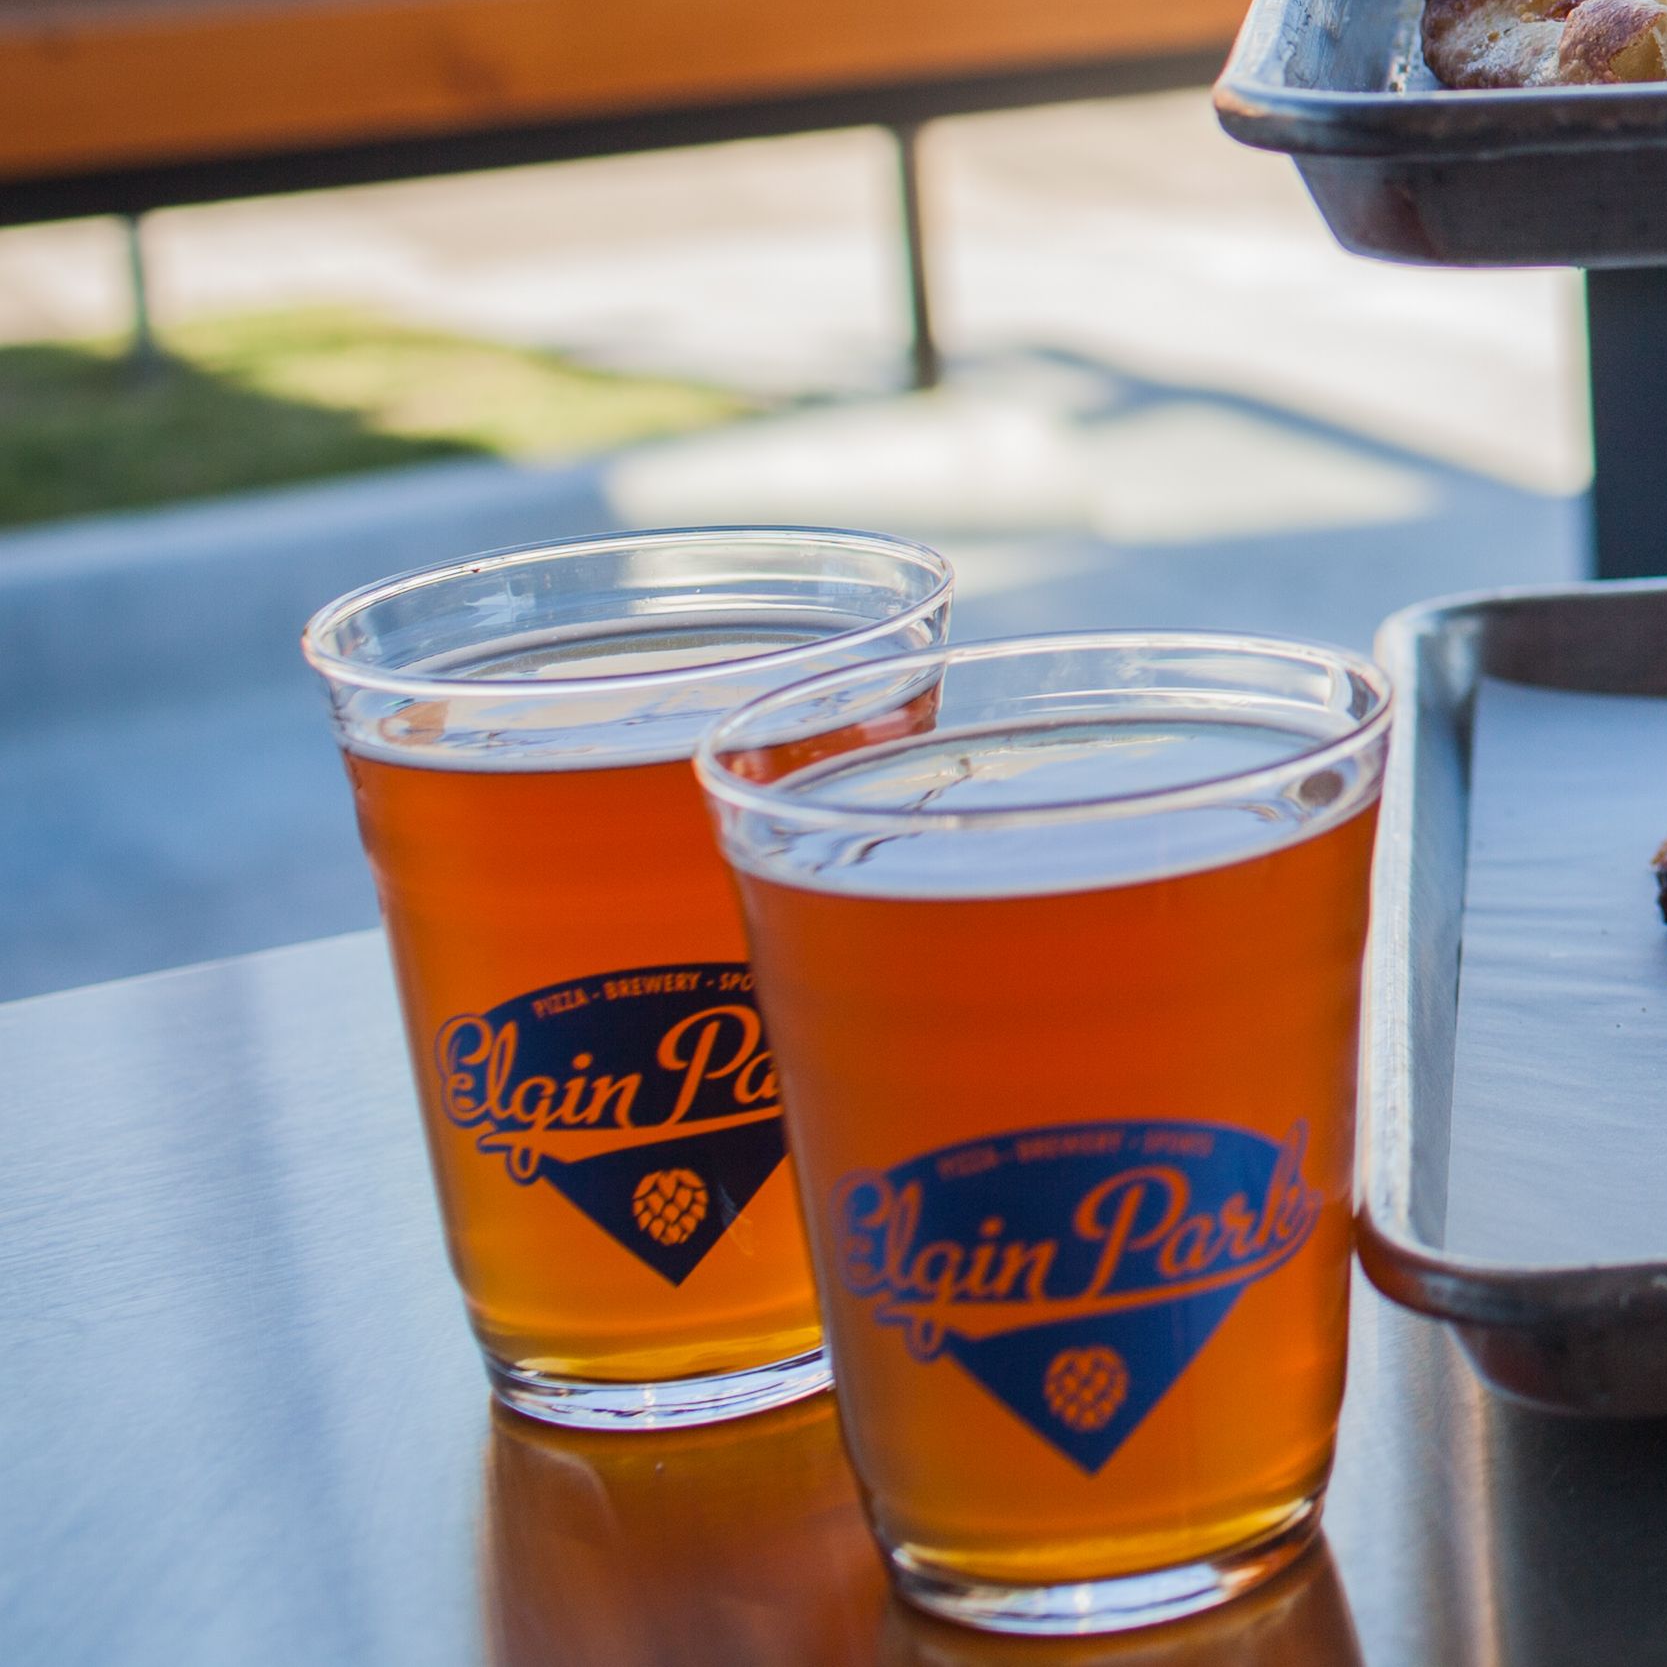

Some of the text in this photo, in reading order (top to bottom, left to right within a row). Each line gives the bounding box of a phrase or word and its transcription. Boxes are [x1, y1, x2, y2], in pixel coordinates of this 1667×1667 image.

[531, 971, 754, 1020] PIZZA BREWERY SPO
[437, 1004, 780, 1180] Elgin Pa
[833, 1118, 1322, 1358] Elgin Park
